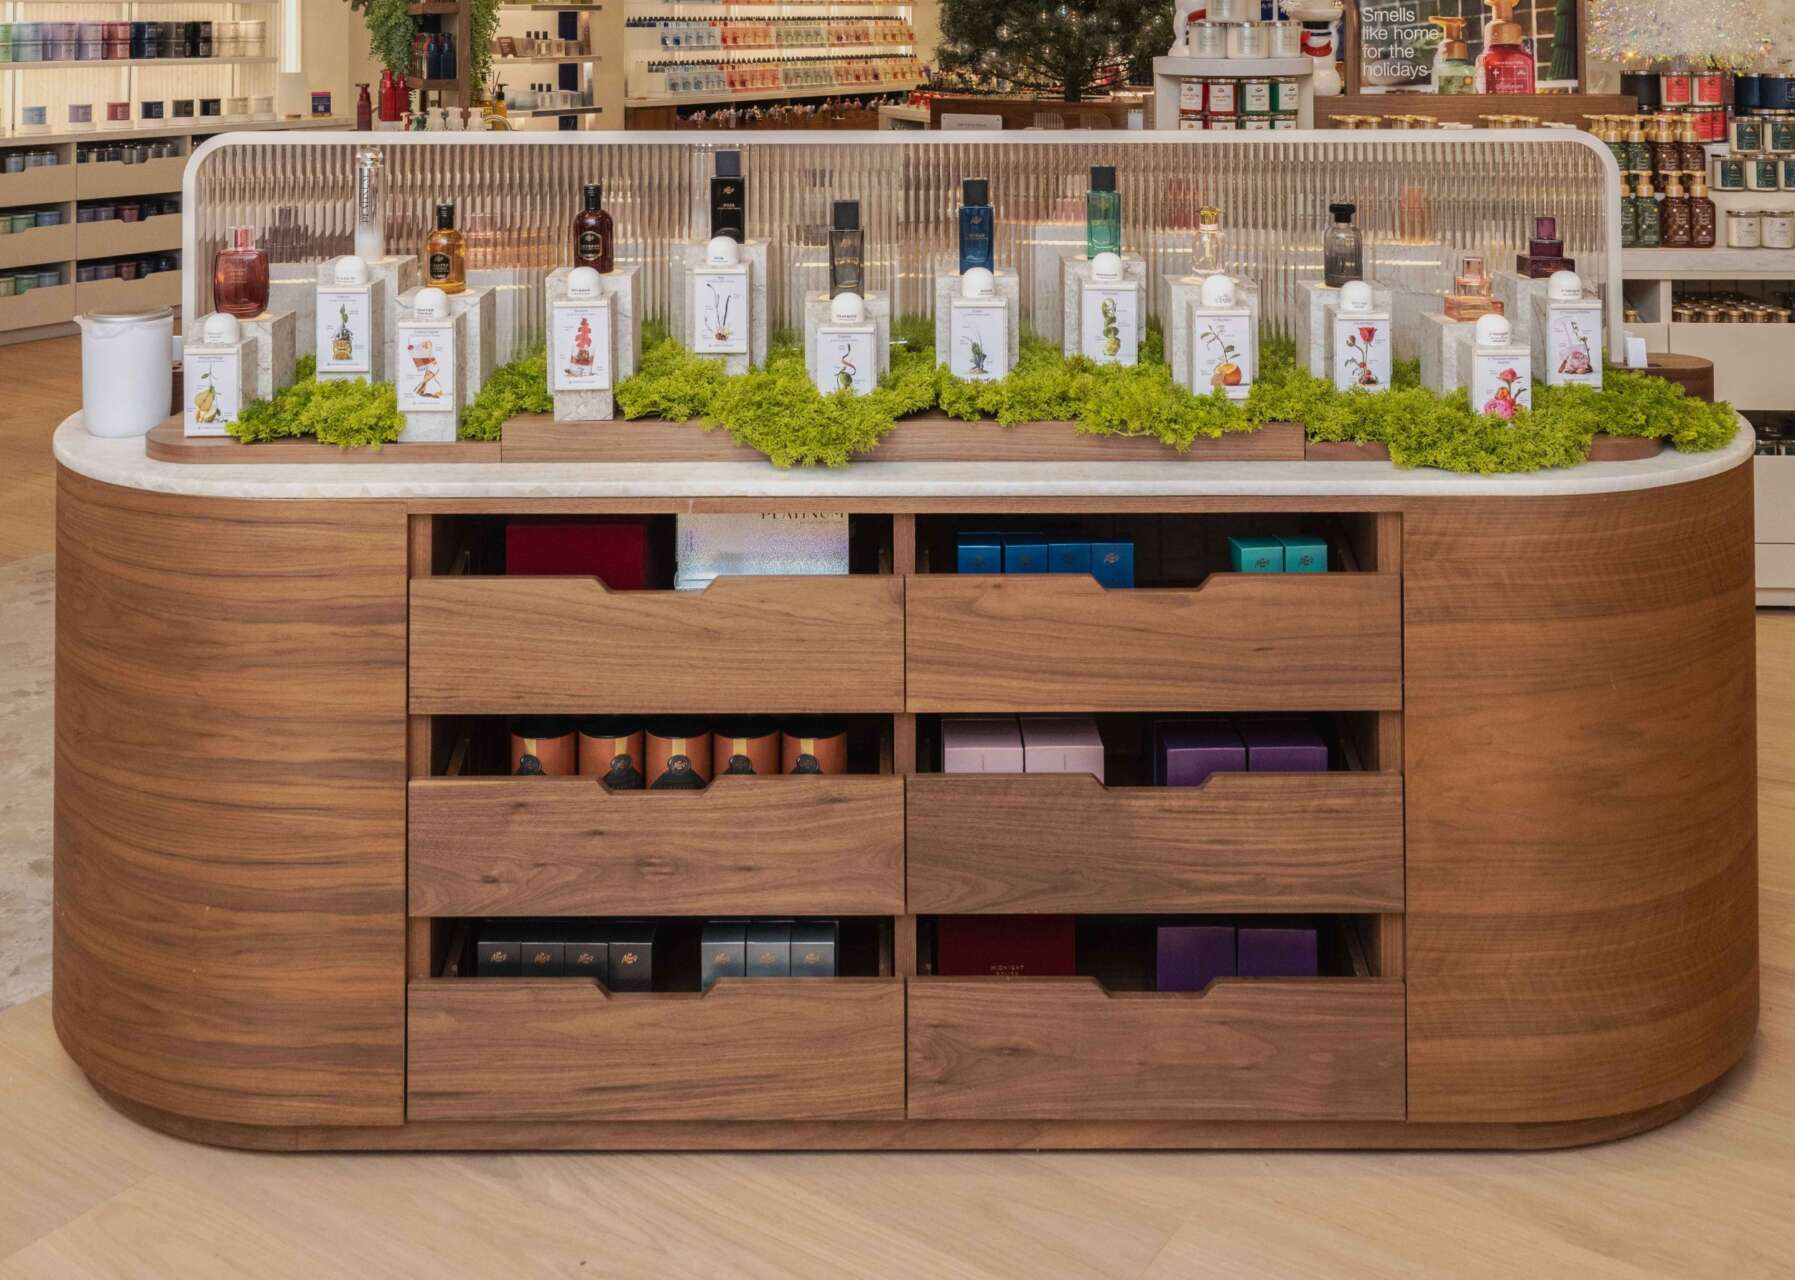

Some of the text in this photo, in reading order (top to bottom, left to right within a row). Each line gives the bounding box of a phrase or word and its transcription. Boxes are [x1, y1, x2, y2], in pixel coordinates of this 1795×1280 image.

[1362, 7, 1416, 22] Smells
[1362, 25, 1440, 40] like home
[1362, 43, 1415, 58] for the
[1363, 62, 1428, 80] holidays
